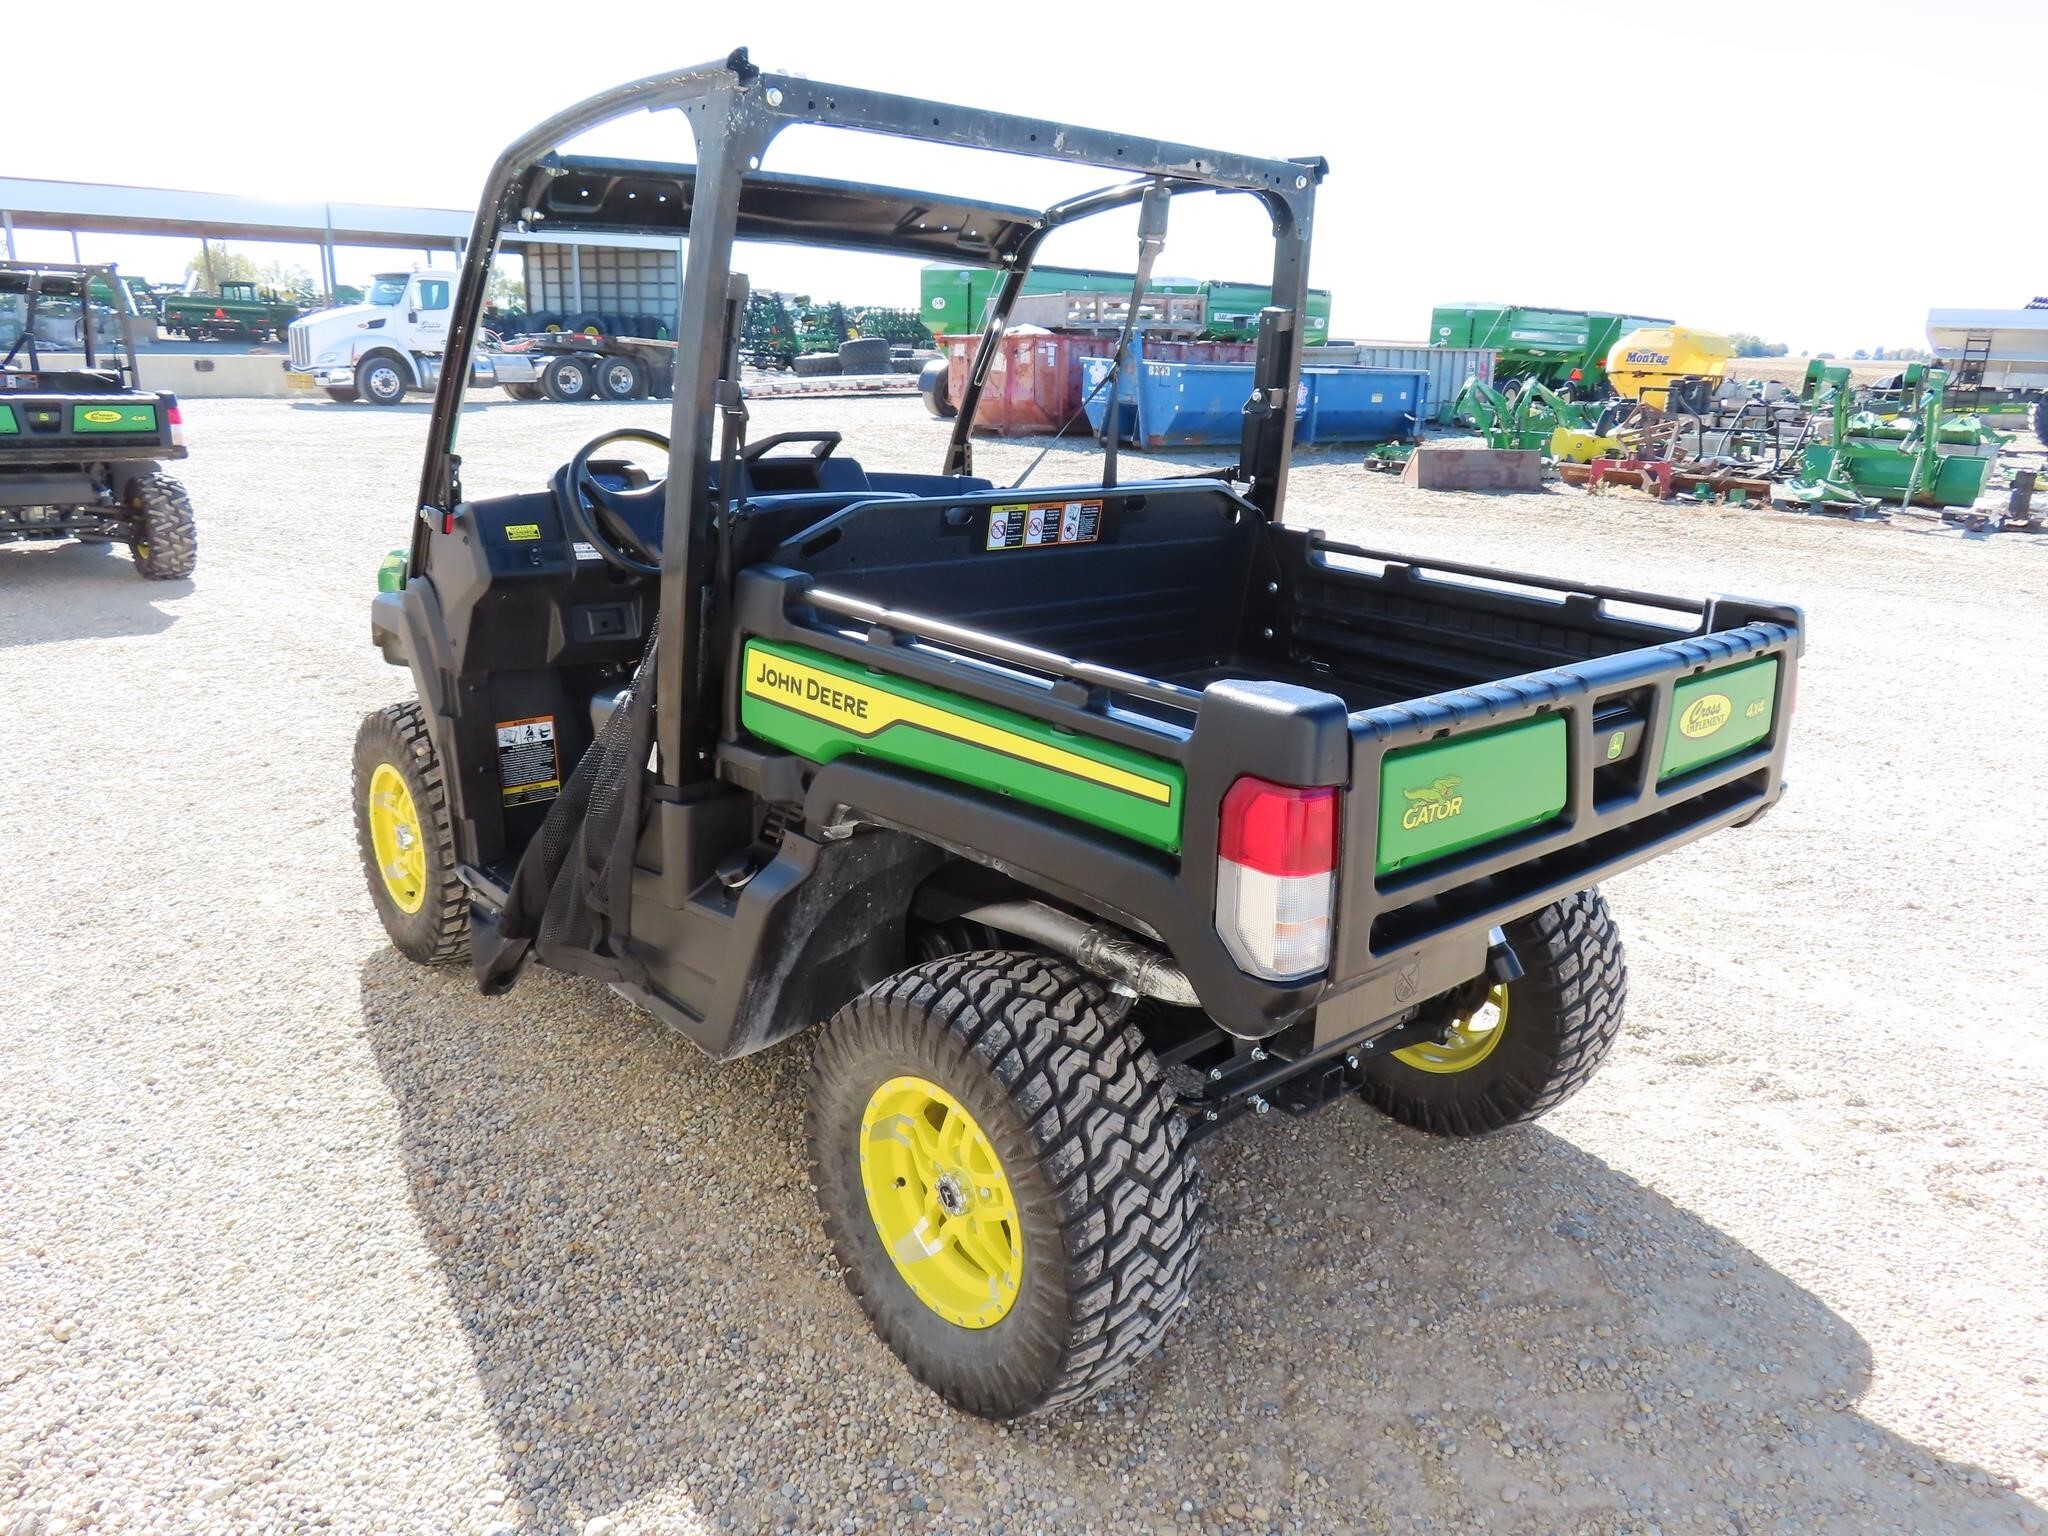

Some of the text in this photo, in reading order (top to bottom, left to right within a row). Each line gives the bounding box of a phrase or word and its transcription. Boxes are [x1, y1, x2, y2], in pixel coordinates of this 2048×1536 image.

[1626, 350, 1671, 366] MonTag
[757, 663, 868, 720] JOHN DEERE
[1686, 714, 1726, 734] IMPLEMENT
[1689, 700, 1722, 724] Cross
[1402, 796, 1463, 830] GATOR
